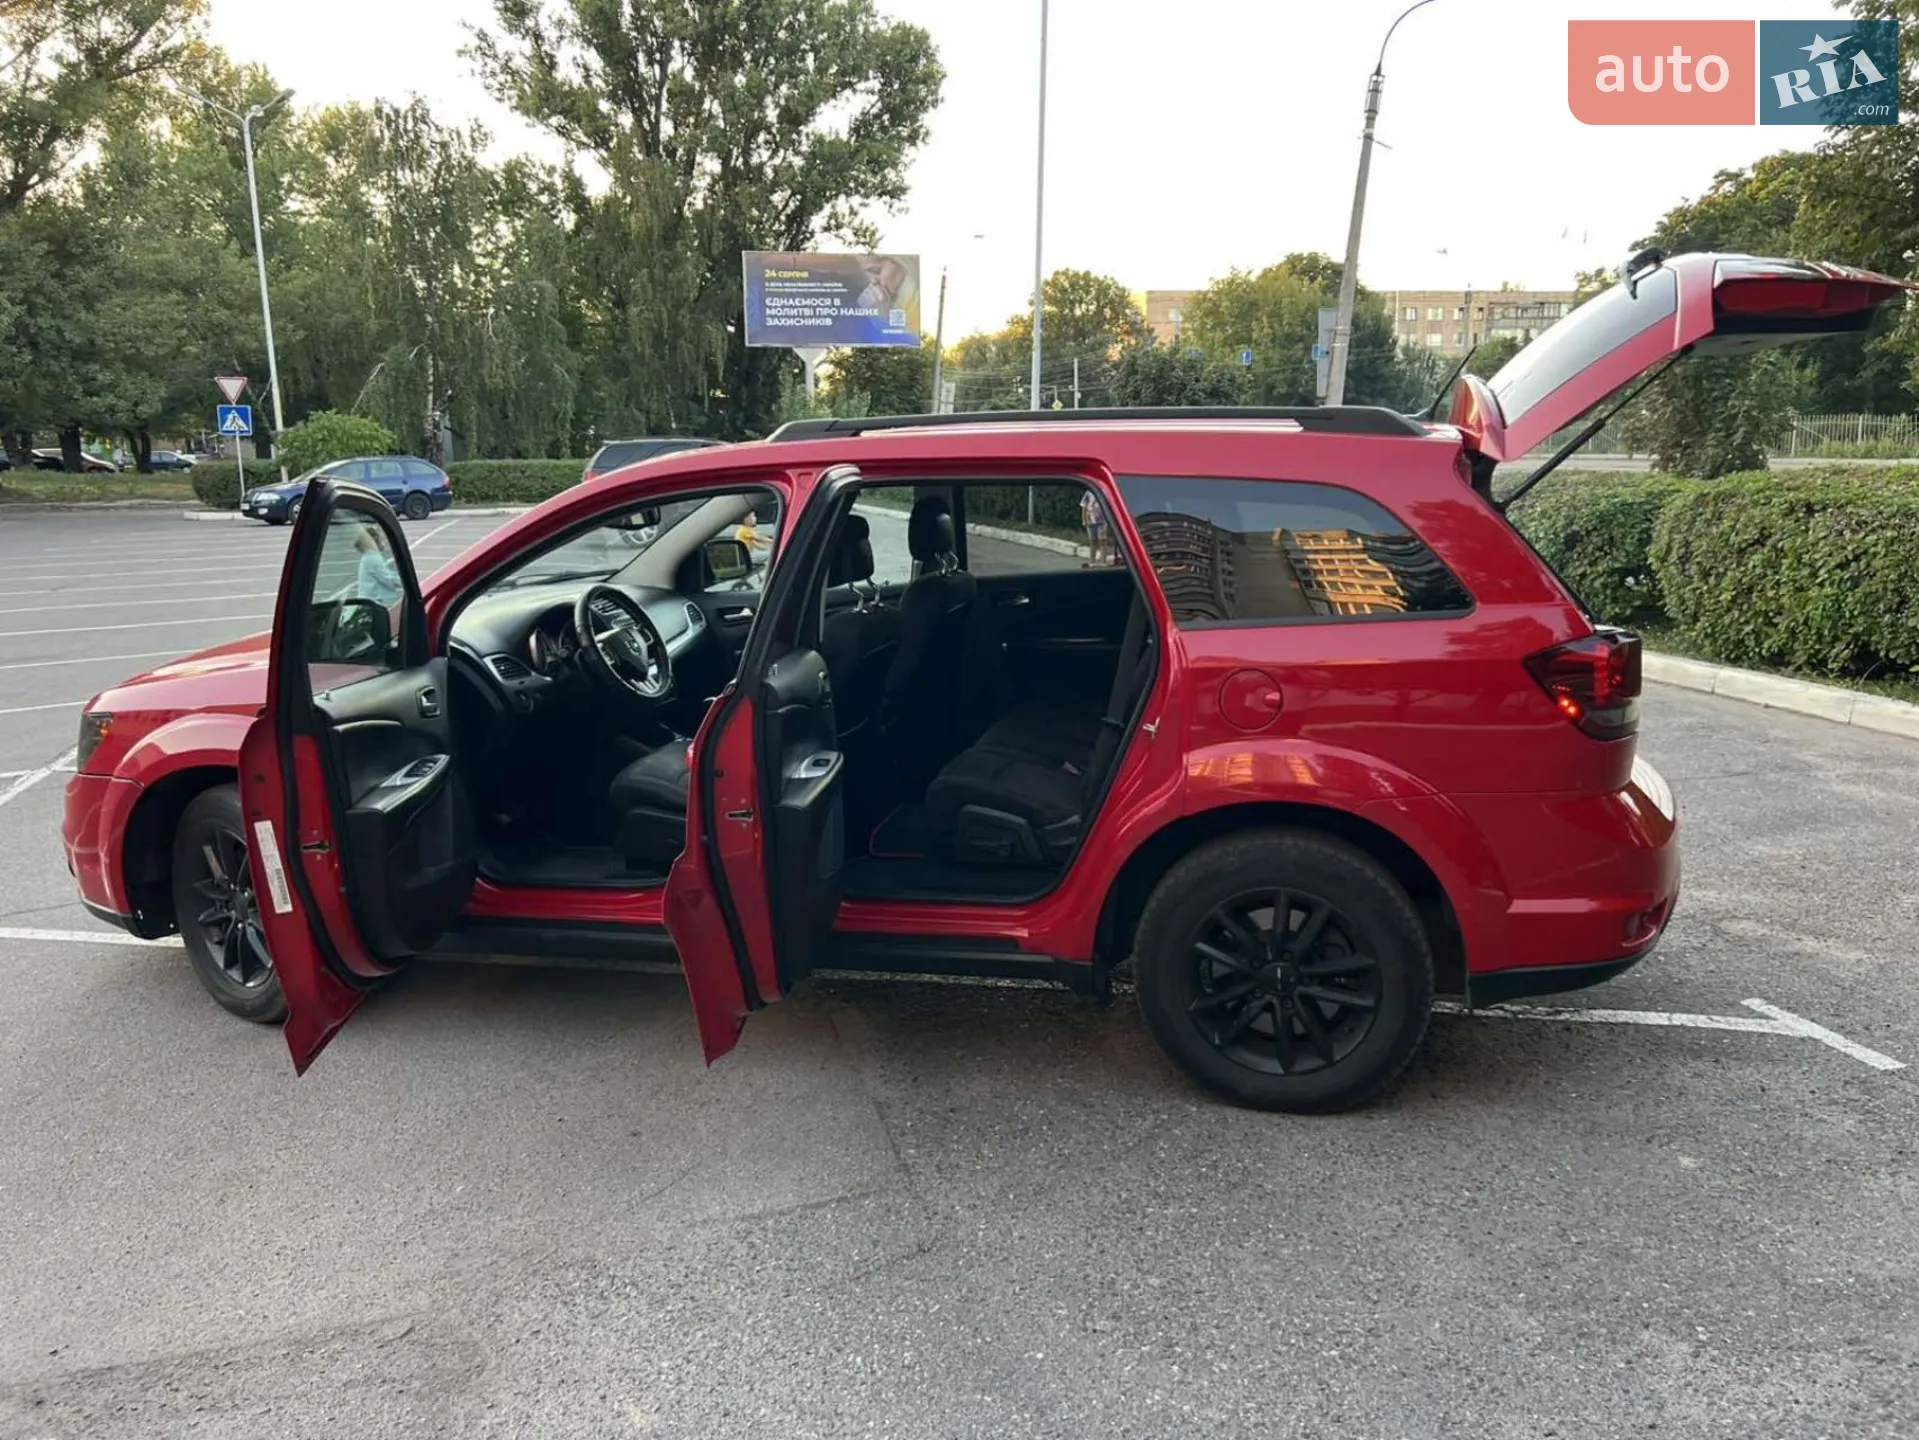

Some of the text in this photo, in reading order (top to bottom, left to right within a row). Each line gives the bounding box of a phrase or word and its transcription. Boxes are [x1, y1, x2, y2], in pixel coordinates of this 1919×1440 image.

[765, 269, 776, 278] 24
[765, 297, 832, 307] ЄДНАЄМОСЯ
[765, 307, 879, 316] МОЛИТВІ ПРО НАШИХ
[765, 317, 832, 326] ЗАХИСНИКІВ
